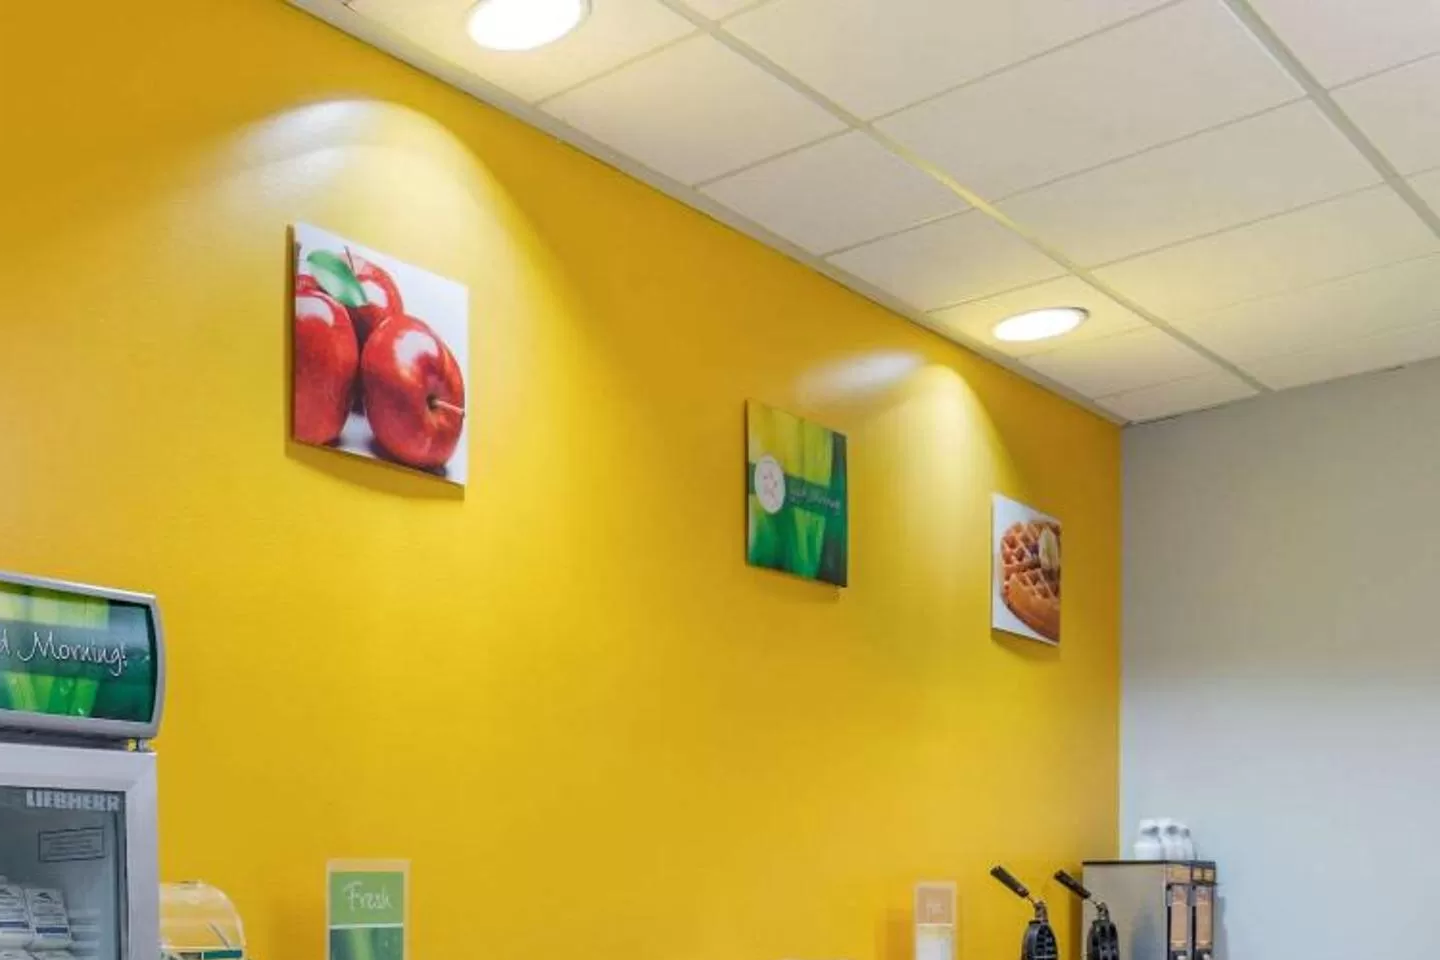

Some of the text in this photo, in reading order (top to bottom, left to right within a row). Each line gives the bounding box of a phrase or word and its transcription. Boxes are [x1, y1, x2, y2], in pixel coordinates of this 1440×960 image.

[17, 630, 129, 677] Morning!
[25, 789, 120, 812] LIEBHERR
[342, 881, 393, 912] Fresh
